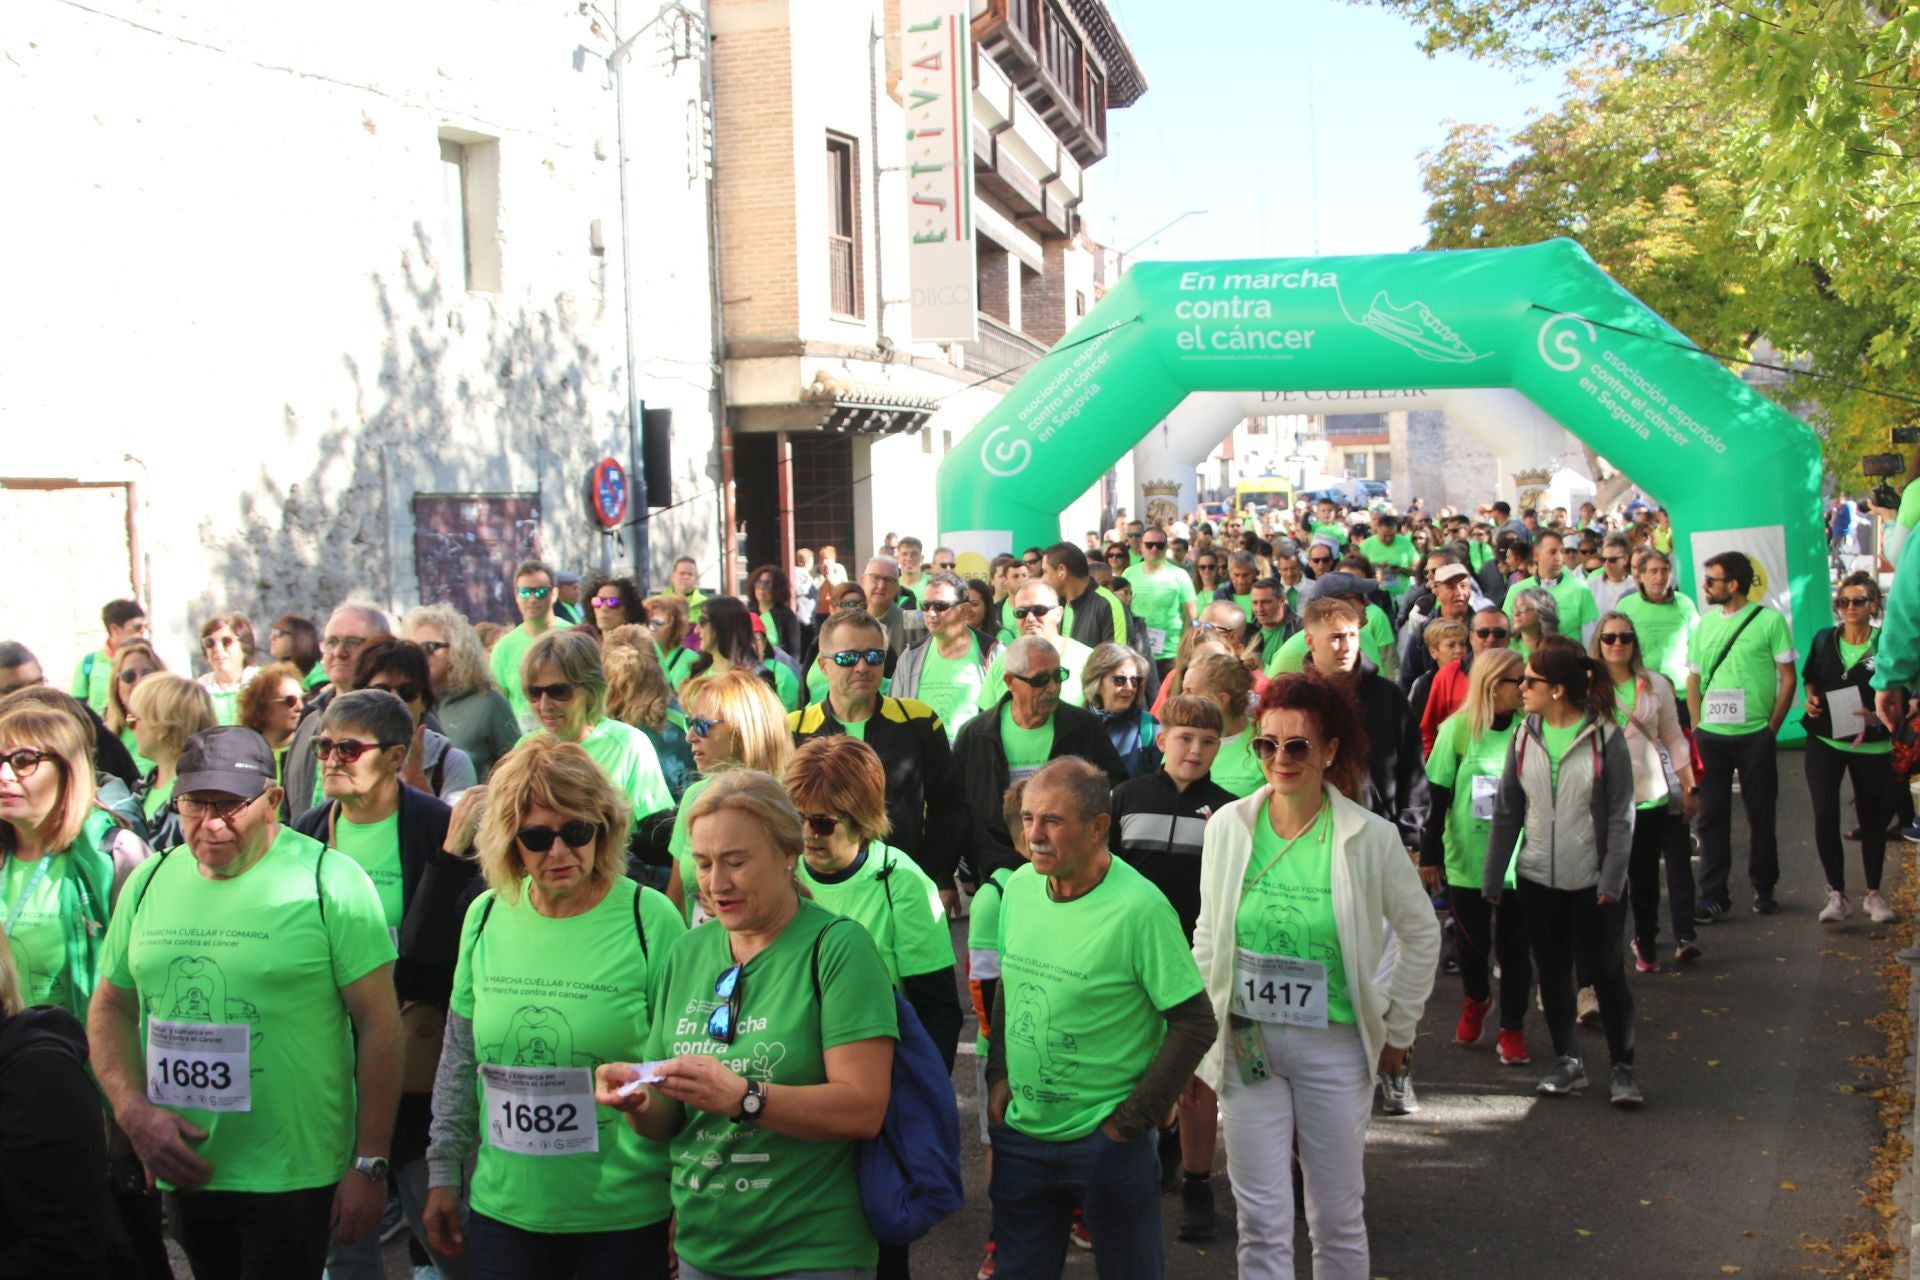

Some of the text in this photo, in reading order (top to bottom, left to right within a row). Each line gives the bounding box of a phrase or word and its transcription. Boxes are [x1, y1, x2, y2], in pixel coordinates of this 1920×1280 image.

[1179, 269, 1337, 291] En marcha
[911, 285, 970, 308] DISCO
[1175, 295, 1272, 319] contra
[1176, 325, 1315, 350] el cáncer
[1028, 397, 1062, 431] contra
[1062, 383, 1075, 398] el
[1038, 383, 1102, 443] en Segovia
[1579, 377, 1650, 440] en Segovia
[1590, 363, 1690, 447] contra el cáncer
[1602, 350, 1727, 454] asociación española
[1709, 702, 1738, 714] 2076
[174, 938, 201, 946] contra
[212, 939, 239, 947] cáncer
[225, 929, 269, 940] COMARCA
[490, 976, 522, 985] MARCHA
[523, 976, 563, 987] CUÉLLAR
[572, 981, 619, 993] COMARCA
[492, 986, 519, 994] marcha
[520, 988, 547, 996] contra
[558, 990, 589, 1000] cáncer
[1245, 979, 1312, 1007] 1417
[676, 1018, 697, 1035] En
[673, 1040, 728, 1056] contra
[158, 1057, 231, 1090] 1683
[502, 1101, 578, 1133] 1682
